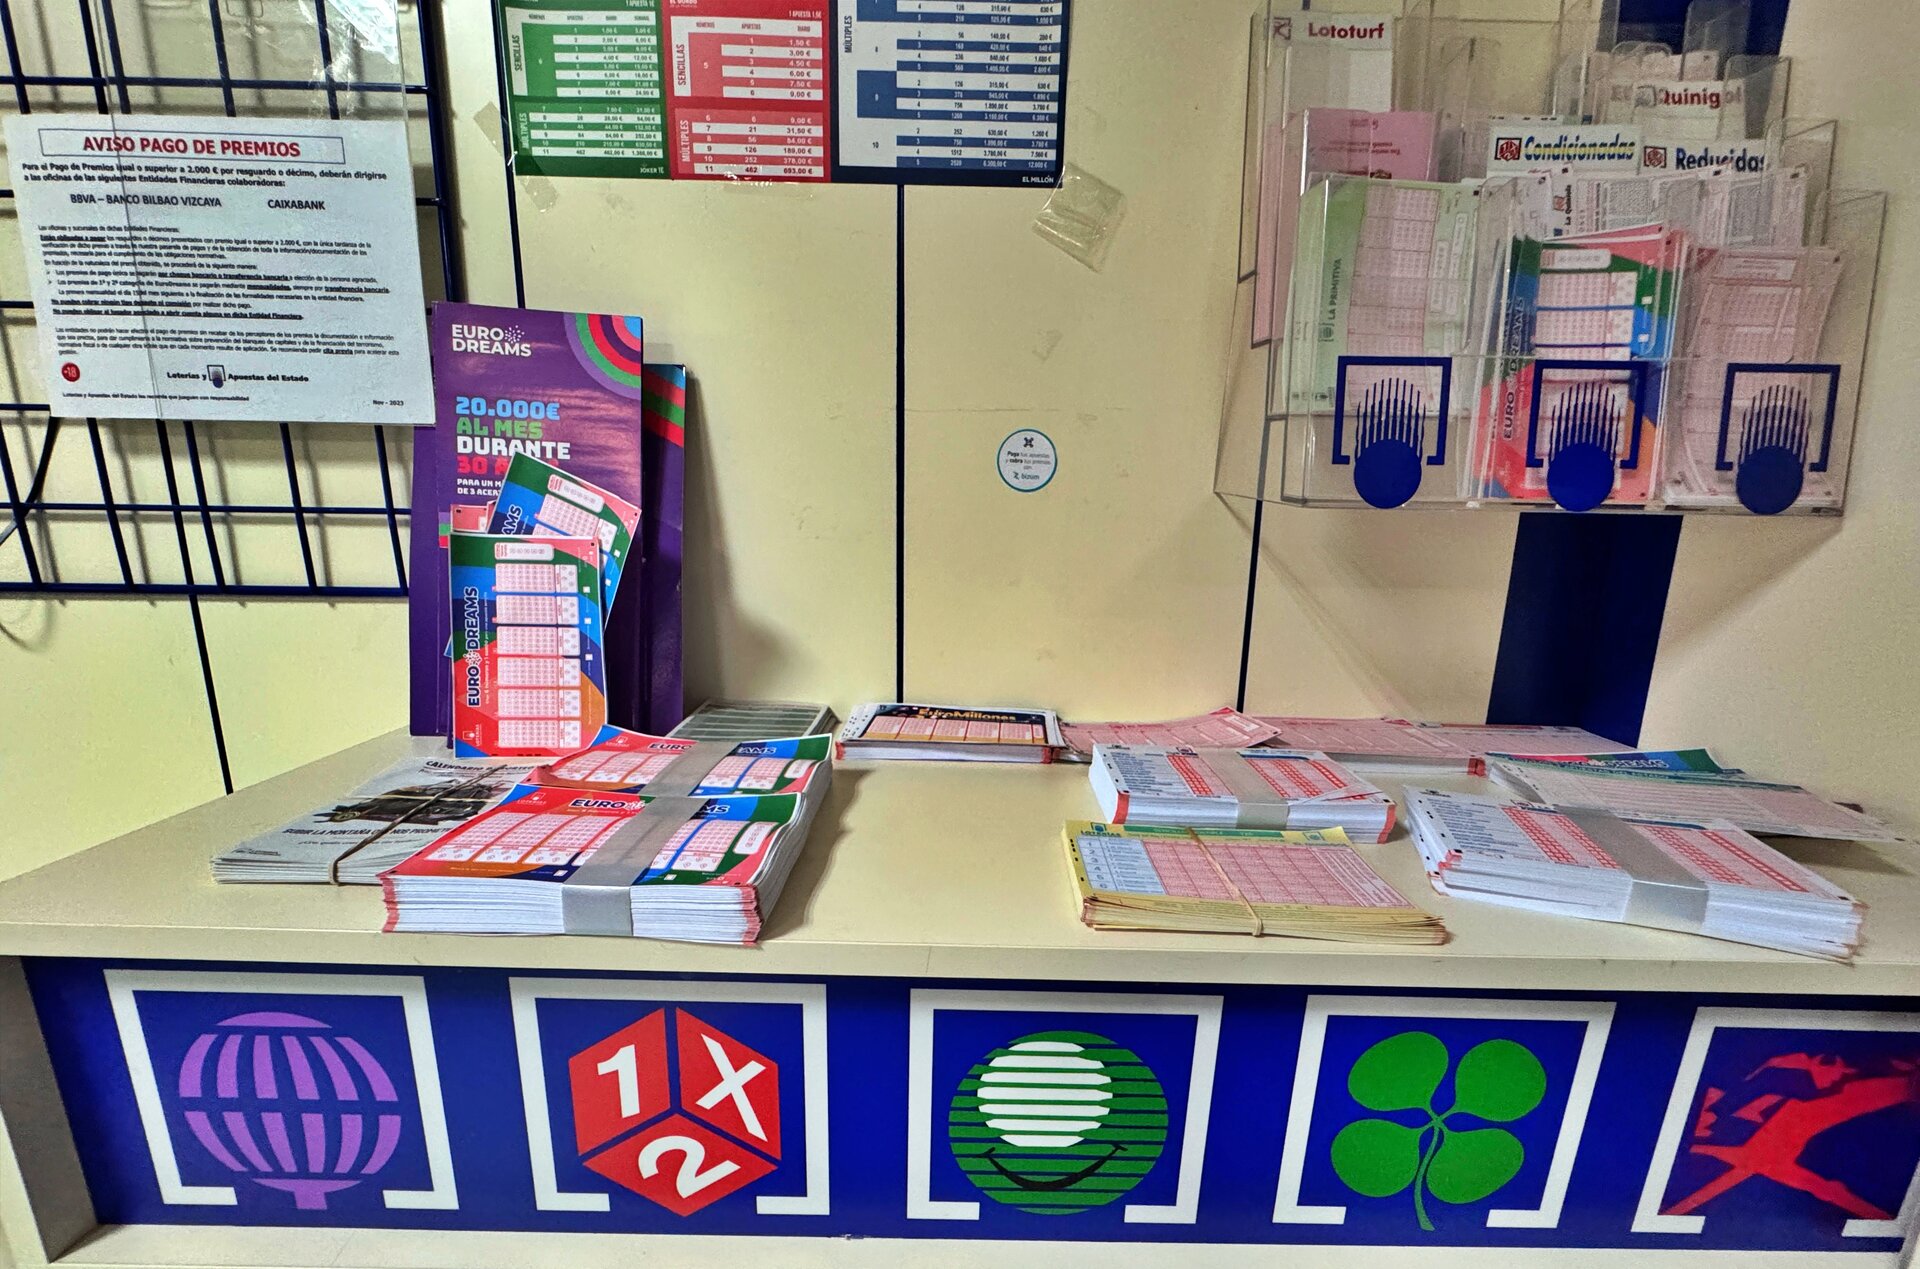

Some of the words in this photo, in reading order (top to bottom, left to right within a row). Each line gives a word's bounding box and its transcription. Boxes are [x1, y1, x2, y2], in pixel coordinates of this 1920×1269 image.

[1308, 22, 1384, 38] Lototurf
[512, 34, 522, 71] SENCILLAS
[676, 44, 686, 86] SENCILLAS
[84, 136, 135, 152] AVISO
[141, 137, 188, 154] PAGO
[193, 140, 216, 154] DE
[220, 140, 300, 157] PREMIOS
[680, 120, 690, 162] MÚLTIPLES
[1524, 134, 1635, 161] Condicionadas
[50, 164, 69, 172] Pago
[145, 165, 177, 173] superior
[236, 168, 276, 176] resguardo
[286, 169, 317, 178] décimo,
[320, 170, 351, 178] deberán
[354, 171, 387, 180] dirigirse
[98, 175, 136, 183] siguientes
[228, 178, 285, 187] colaboradoras:
[1031, 175, 1053, 183] MILLÓN
[71, 194, 96, 204] BBVA
[107, 195, 139, 205] BANCO
[143, 195, 178, 206] BILBAO
[181, 196, 221, 206] VIZCAYA
[268, 199, 325, 210] CAIXABANK
[1330, 258, 1341, 306] PRIMITIVA
[1328, 308, 1336, 320] LA
[452, 324, 504, 340] EURO
[452, 339, 531, 357] DREAMS
[228, 373, 264, 382] Apuestas
[456, 397, 560, 420] 20.000€
[1504, 391, 1514, 439] EURO
[456, 417, 488, 436] AL
[494, 420, 543, 439] MES
[457, 436, 570, 460] DURANTE
[458, 456, 488, 474] 30
[465, 587, 479, 650] DREAMS
[468, 666, 481, 707] EURO
[919, 707, 1015, 721] EuroMillones
[426, 761, 483, 771] CALENDARIO
[571, 798, 625, 809] EURO
[326, 827, 371, 836] MONTAÑA
[597, 1044, 640, 1118] 1
[695, 1033, 768, 1142] X
[638, 1135, 741, 1199] 2
